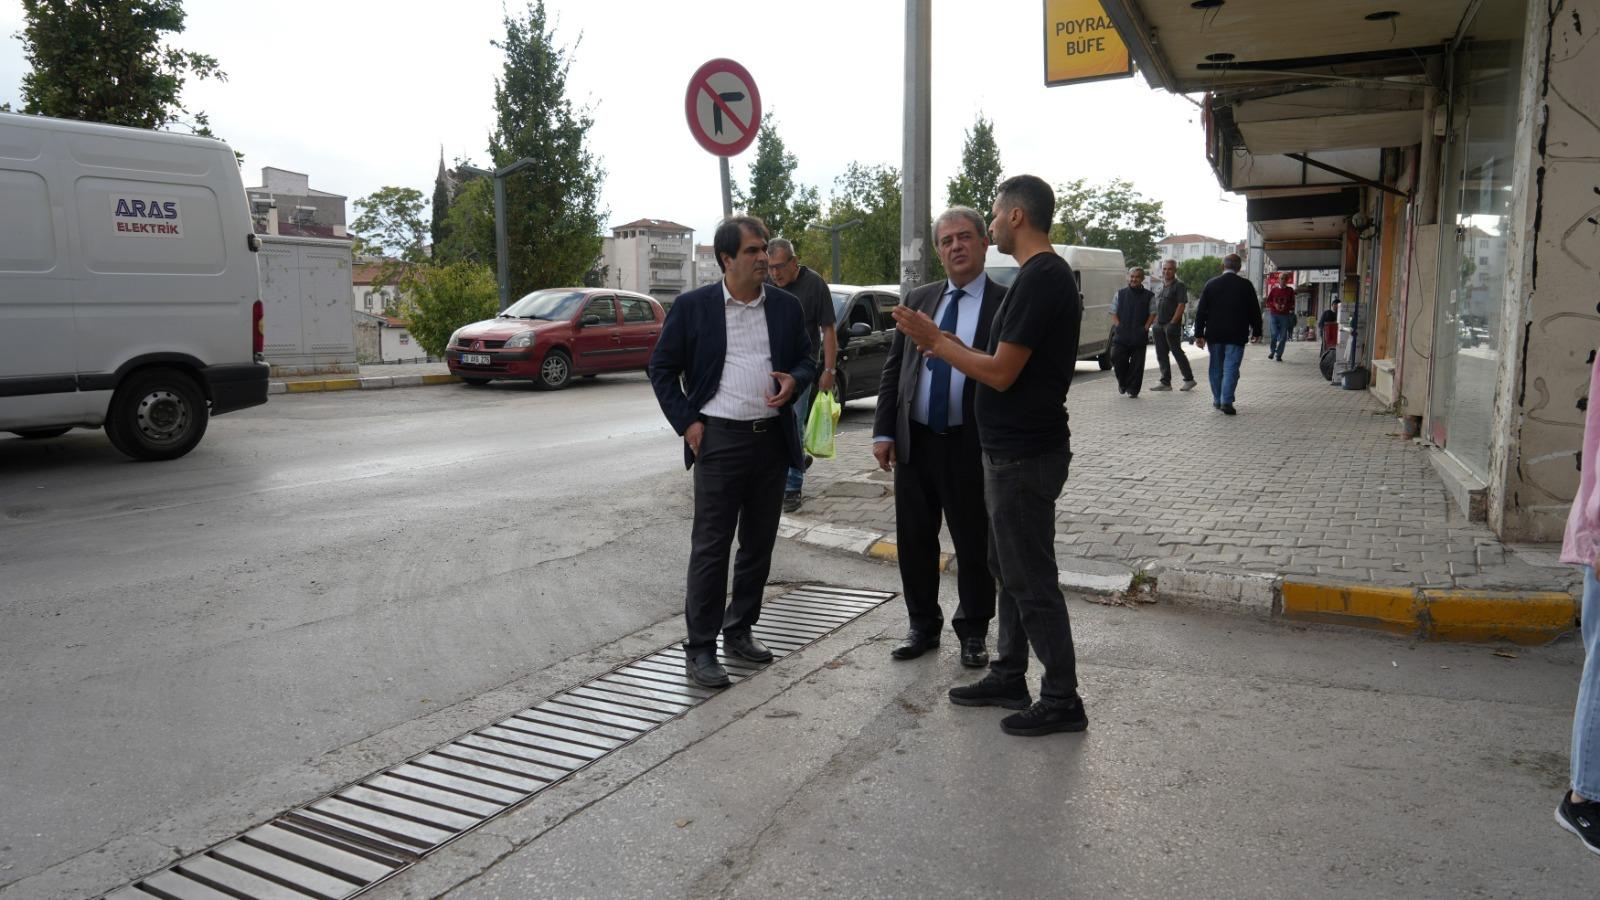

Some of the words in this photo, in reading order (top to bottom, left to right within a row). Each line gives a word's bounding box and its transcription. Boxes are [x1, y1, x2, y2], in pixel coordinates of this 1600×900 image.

[1056, 16, 1115, 36] POYRAZ
[1066, 36, 1105, 56] BÜFE
[115, 198, 178, 219] ARAS
[116, 221, 180, 235] ELEKTRİK
